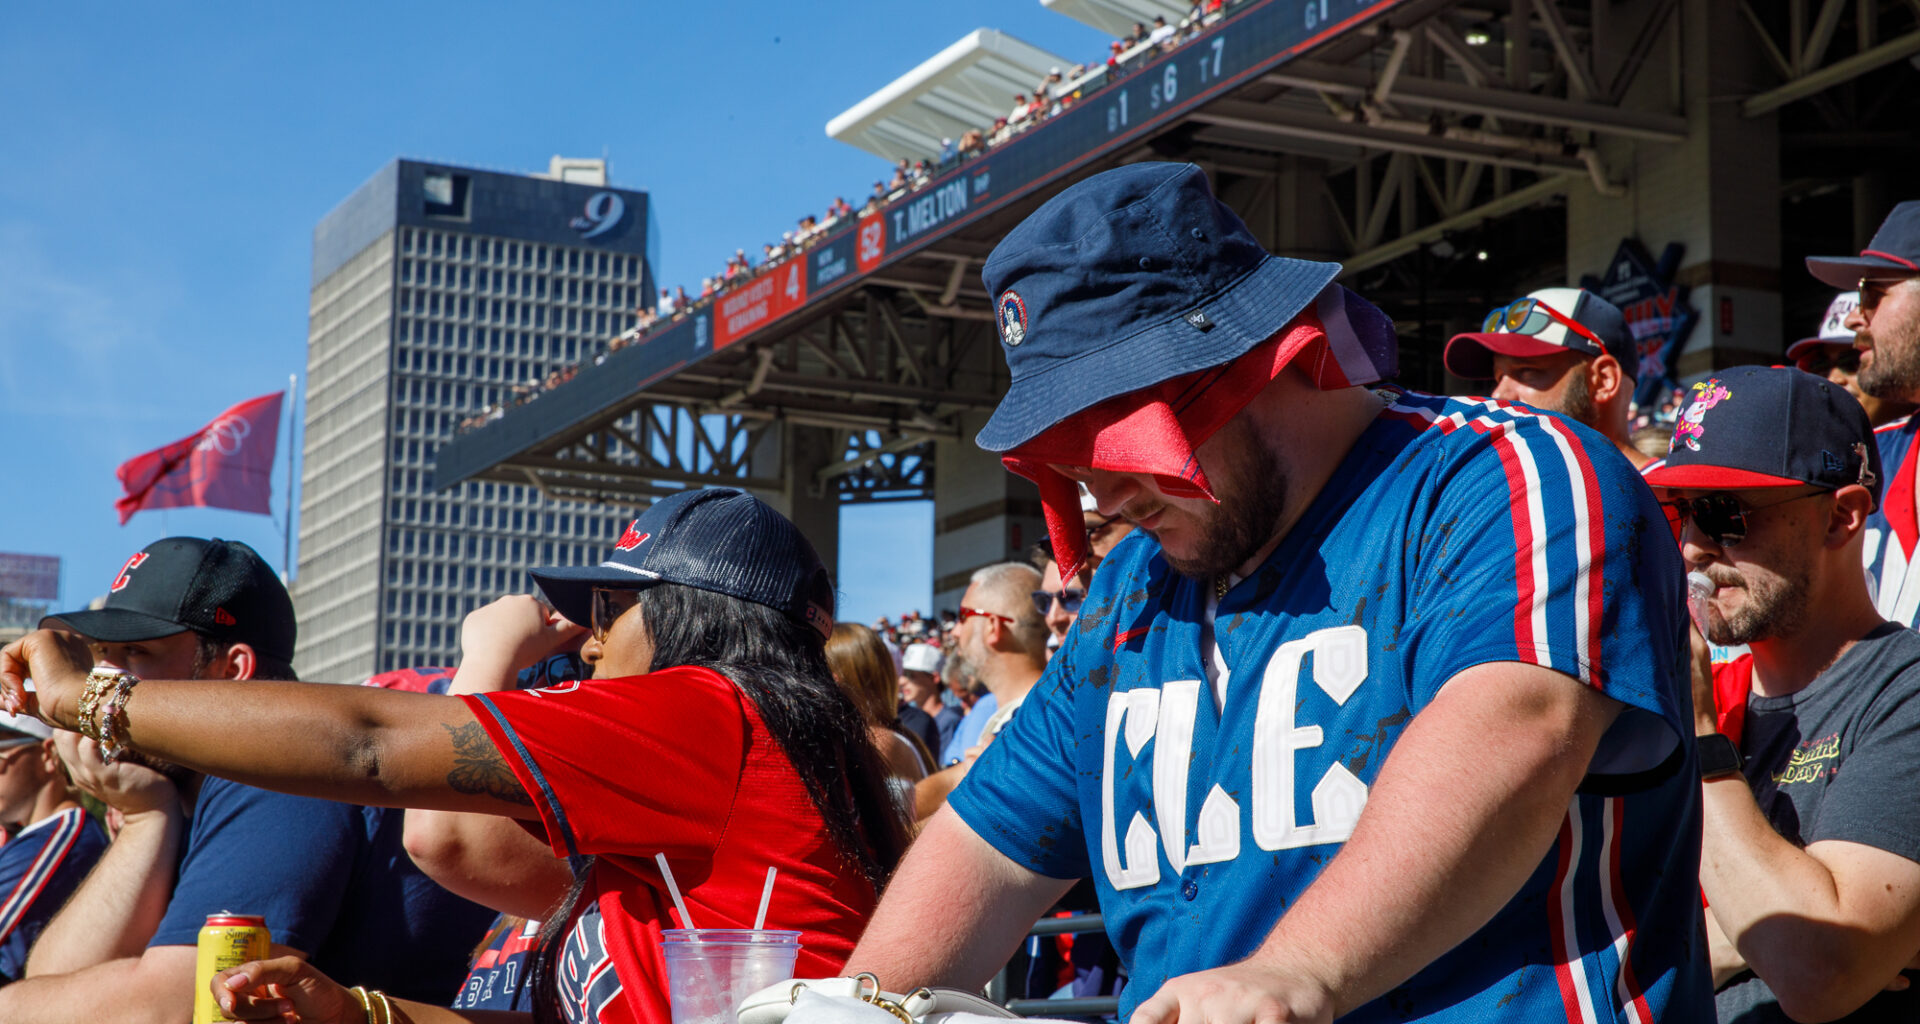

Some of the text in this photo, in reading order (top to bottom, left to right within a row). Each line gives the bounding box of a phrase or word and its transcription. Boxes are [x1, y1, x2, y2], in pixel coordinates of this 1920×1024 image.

[1119, 90, 1128, 126] 1
[1151, 83, 1160, 110] S
[1163, 63, 1177, 102] 6
[1199, 56, 1210, 83] T
[1211, 37, 1225, 77] 7
[581, 191, 625, 239] 9
[861, 175, 968, 262] 52 T. MELTON
[785, 263, 800, 301] 4
[111, 552, 150, 593] C
[1101, 624, 1369, 892] CLE
